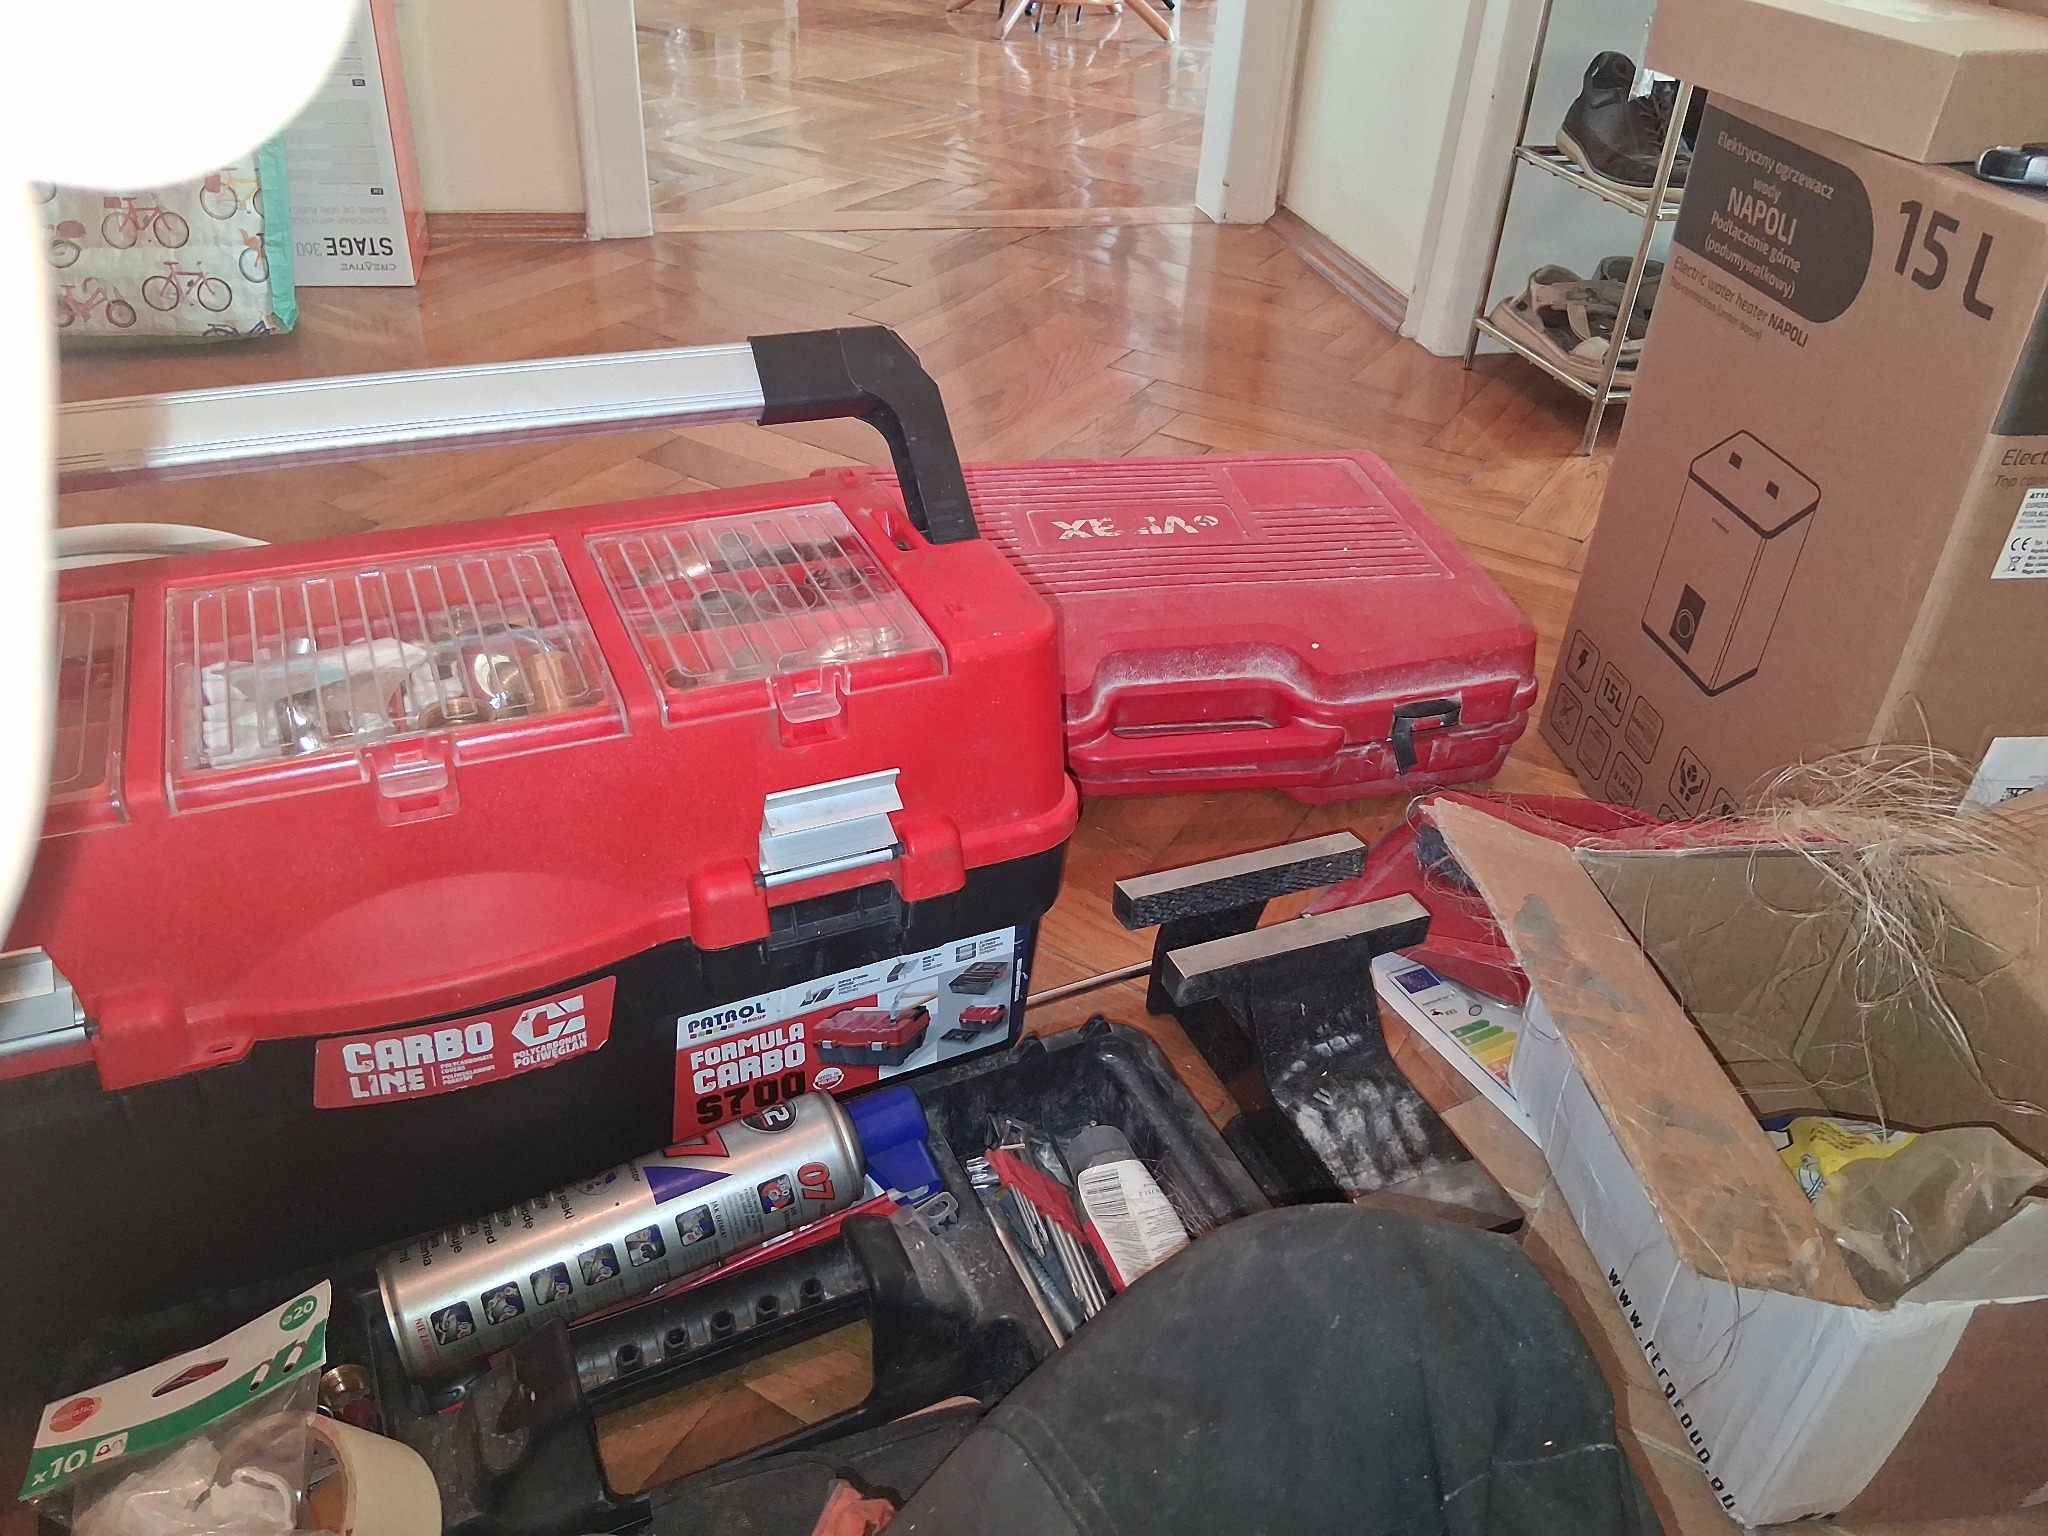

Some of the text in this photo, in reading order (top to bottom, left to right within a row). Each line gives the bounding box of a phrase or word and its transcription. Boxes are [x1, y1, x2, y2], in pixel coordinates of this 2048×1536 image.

[1718, 130, 1835, 200] Elektryczny ogrzewacz
[1753, 177, 1781, 204] wody
[1727, 187, 1797, 245] NAPOLI
[296, 237, 394, 257] STAGE 360
[1711, 211, 1801, 273] Podłączenie górne
[1894, 199, 1994, 322] 15 L
[1674, 255, 1705, 286] Electric
[1707, 279, 1736, 303] water
[1735, 293, 1769, 321] heater
[1767, 313, 1809, 348] NAPOLI
[1603, 677, 1623, 713] 15L
[688, 1001, 766, 1034] PATROL
[741, 1013, 767, 1025] GROUP
[342, 1021, 494, 1074] CARBO
[513, 1031, 588, 1061] POLYCARBONATE
[514, 1039, 588, 1069] POLIWĘGLAN
[690, 1022, 805, 1071] FORMULA
[349, 1067, 425, 1098] LINE
[693, 1042, 806, 1095] CARBO
[695, 1070, 806, 1126] S700
[797, 1161, 836, 1201] 07
[31, 1449, 86, 1487] x10
